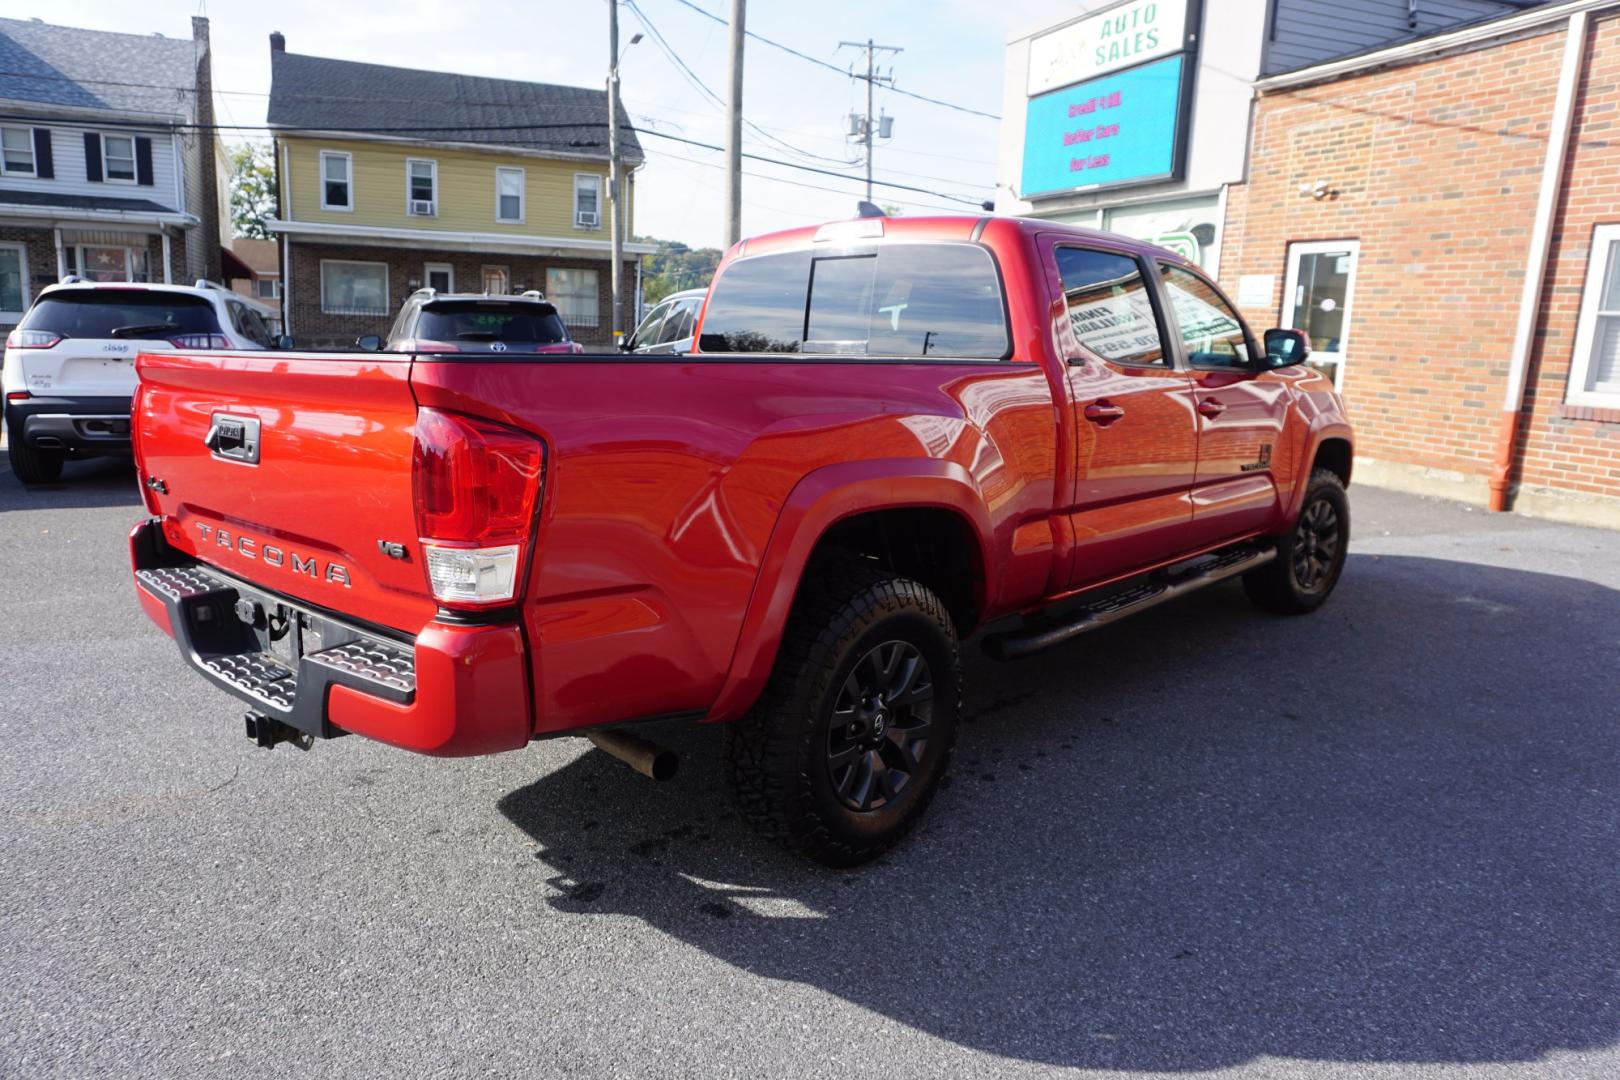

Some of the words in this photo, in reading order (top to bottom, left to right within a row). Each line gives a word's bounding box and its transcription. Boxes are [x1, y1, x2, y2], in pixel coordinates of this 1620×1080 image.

[1101, 3, 1157, 40] AUTO
[1096, 27, 1159, 66] SALES
[196, 521, 352, 588] TACOMA
[377, 539, 404, 558] V6
